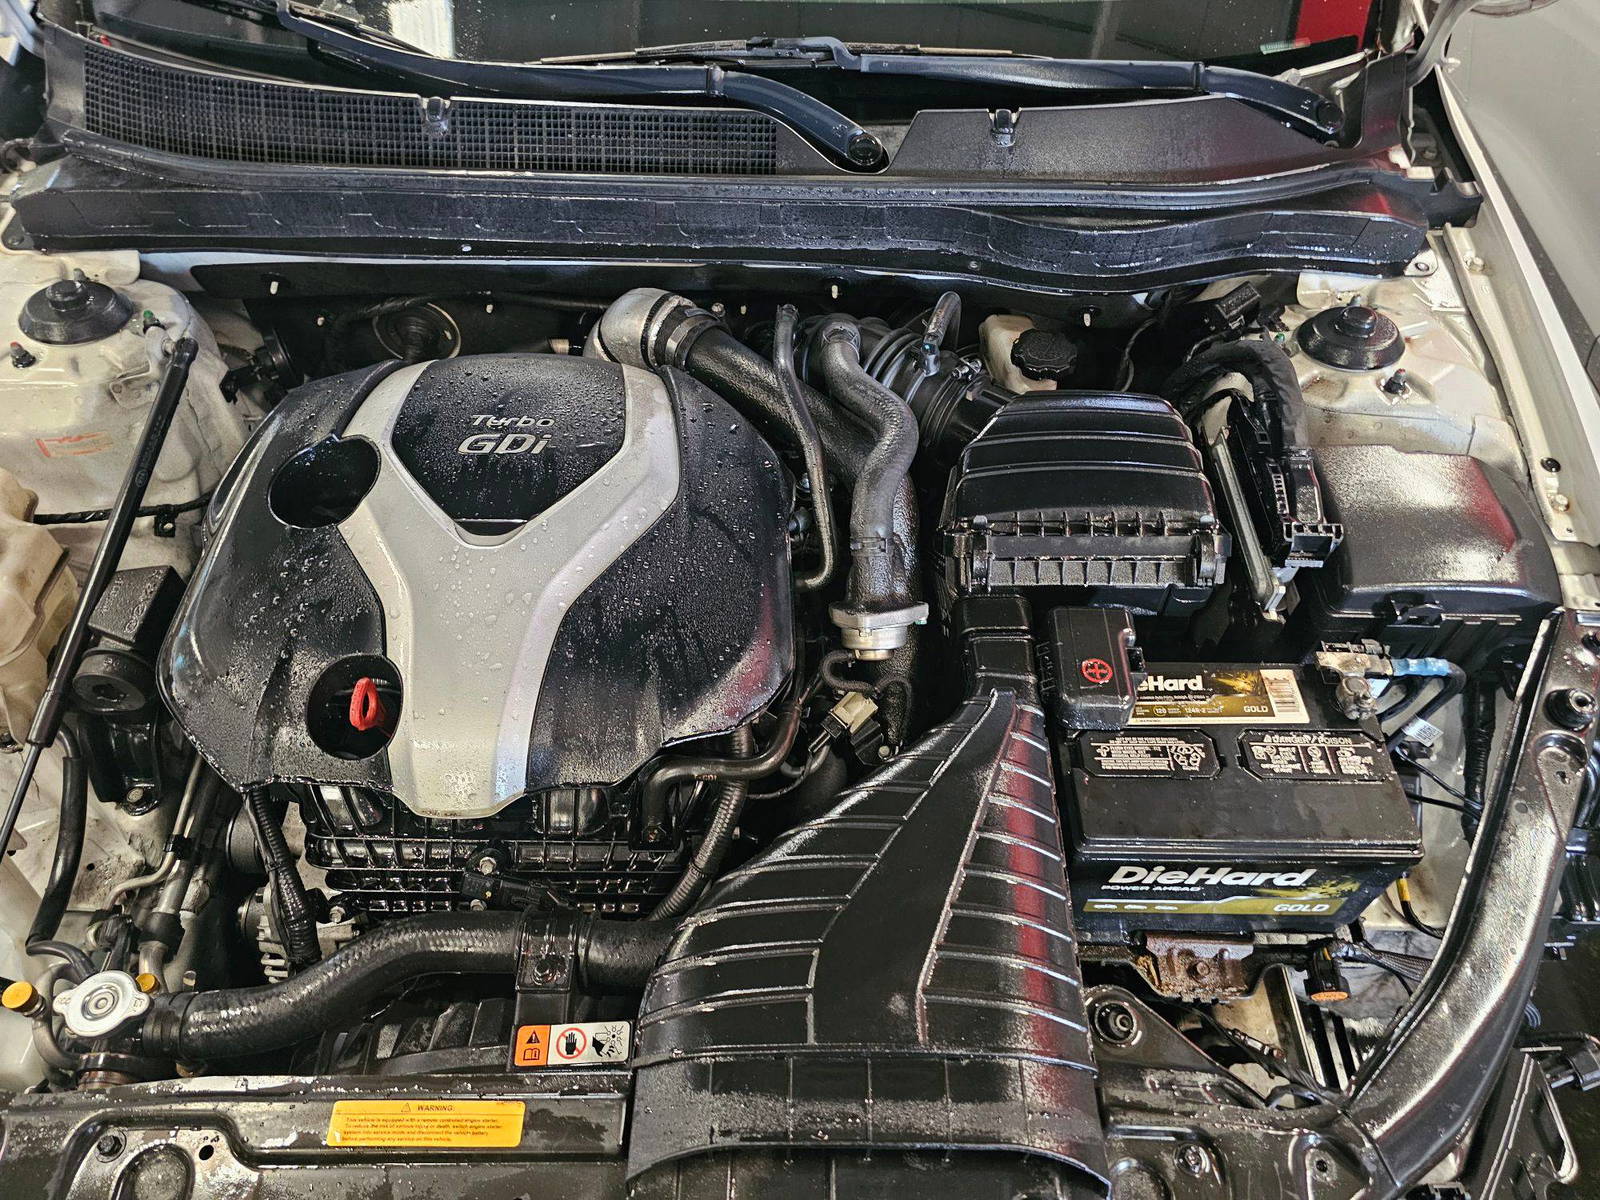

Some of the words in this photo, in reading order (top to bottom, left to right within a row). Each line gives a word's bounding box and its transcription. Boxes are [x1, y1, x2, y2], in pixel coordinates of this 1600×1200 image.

[471, 414, 555, 428] Turbo
[457, 433, 552, 455] GDi
[1243, 705, 1269, 713] GOLD
[1108, 865, 1318, 887] DieHard
[1101, 884, 1150, 892] POWER
[1152, 885, 1201, 893] AHEAD
[1272, 902, 1331, 913] GOLD
